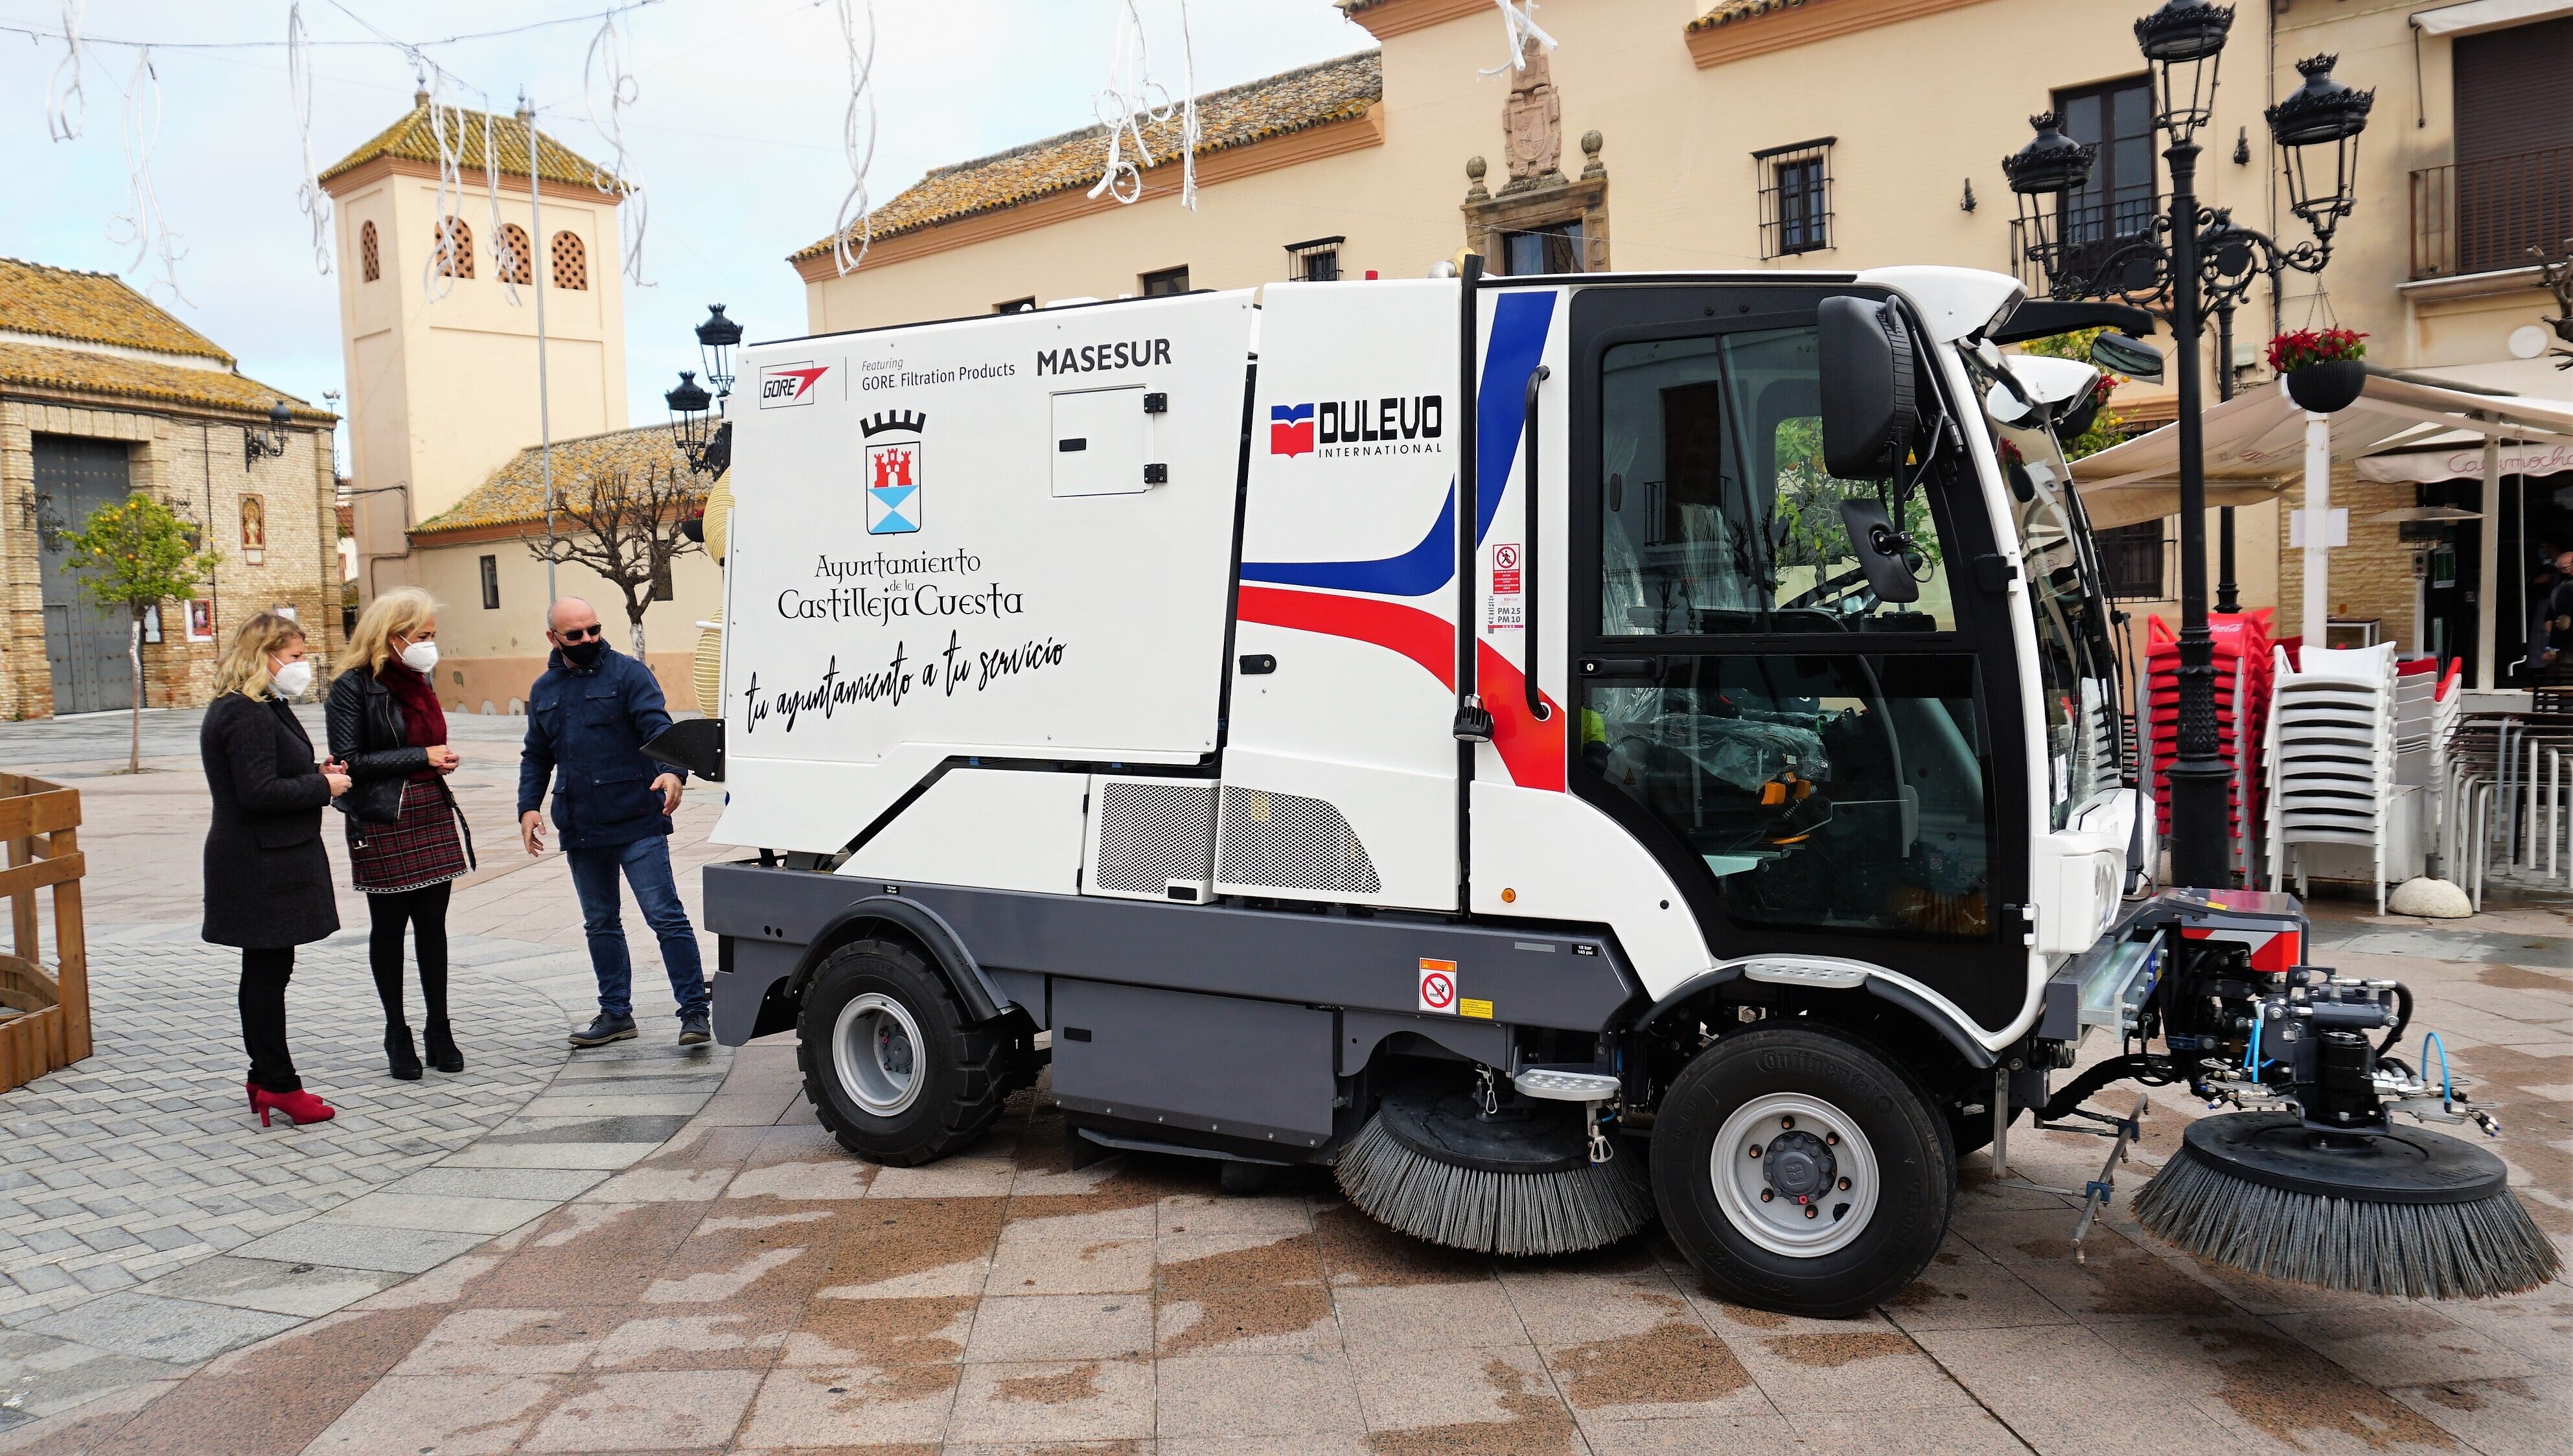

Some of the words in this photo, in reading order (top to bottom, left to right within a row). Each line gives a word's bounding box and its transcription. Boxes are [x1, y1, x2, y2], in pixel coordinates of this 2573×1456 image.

[862, 358, 903, 371] Featuring
[1037, 338, 1172, 376] MASESUR
[763, 375, 796, 399] GORE
[862, 374, 895, 391] GORE
[900, 366, 955, 387] Filtration
[959, 362, 1015, 381] Products
[1319, 395, 1442, 444] DULEVO
[1319, 443, 1442, 458] INTERNATIONAL
[814, 548, 981, 584] Ayuntamiento
[890, 579, 902, 592] de
[905, 579, 914, 591] la
[778, 587, 910, 627] Castilleja
[914, 582, 1024, 619] Cuesta
[744, 671, 770, 734] tu
[776, 640, 914, 733] ayuntamiento
[922, 662, 938, 688] a
[942, 629, 971, 697] tu
[978, 636, 1068, 692] servicio
